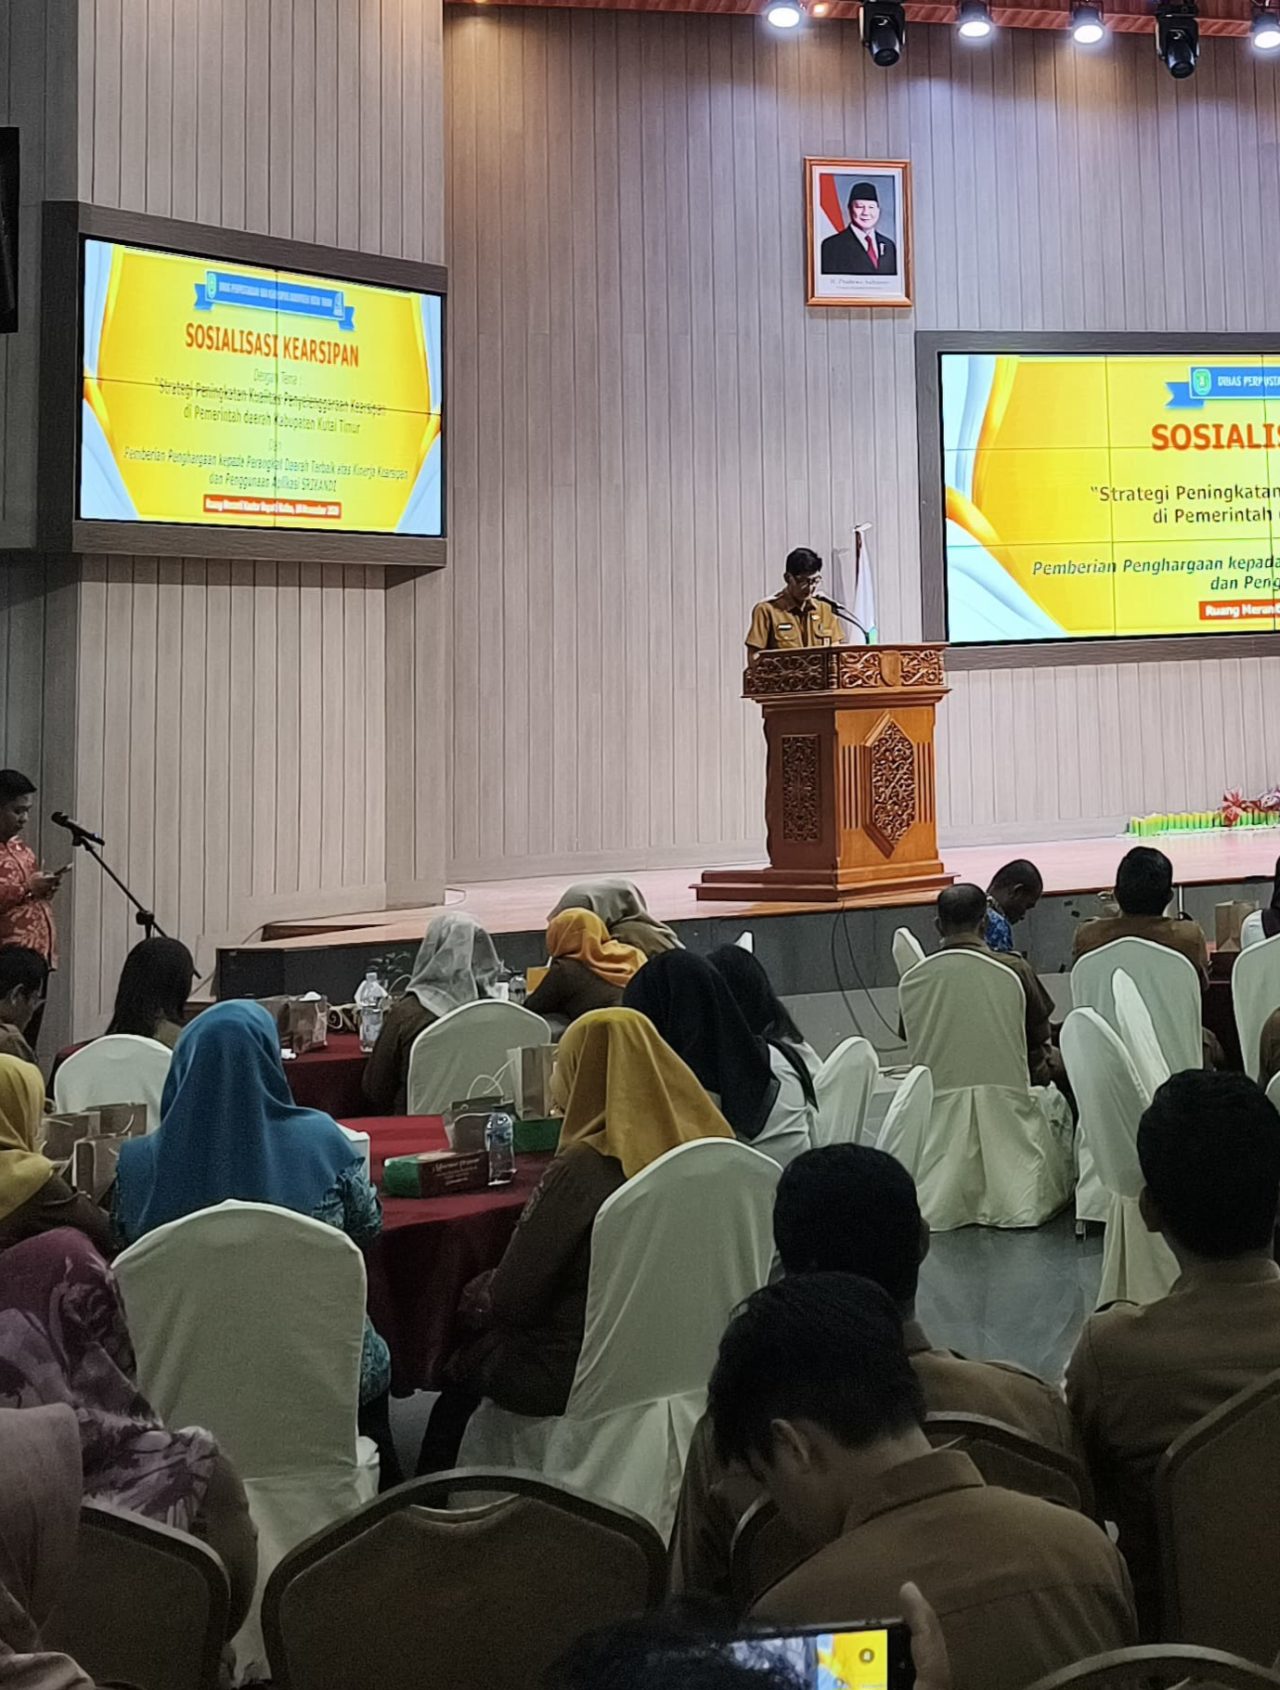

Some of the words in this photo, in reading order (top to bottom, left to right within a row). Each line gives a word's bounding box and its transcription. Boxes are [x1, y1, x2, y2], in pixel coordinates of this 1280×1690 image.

[185, 322, 279, 358] SOSIALISASI
[283, 336, 359, 367] KEARSIPAN
[1153, 508, 1168, 524] di
[1175, 507, 1272, 523] Pemerintah
[1032, 557, 1117, 576] Pemberian
[1123, 557, 1223, 576] Penghargaan
[1210, 575, 1239, 590] dan
[1205, 605, 1241, 618] Ruang
